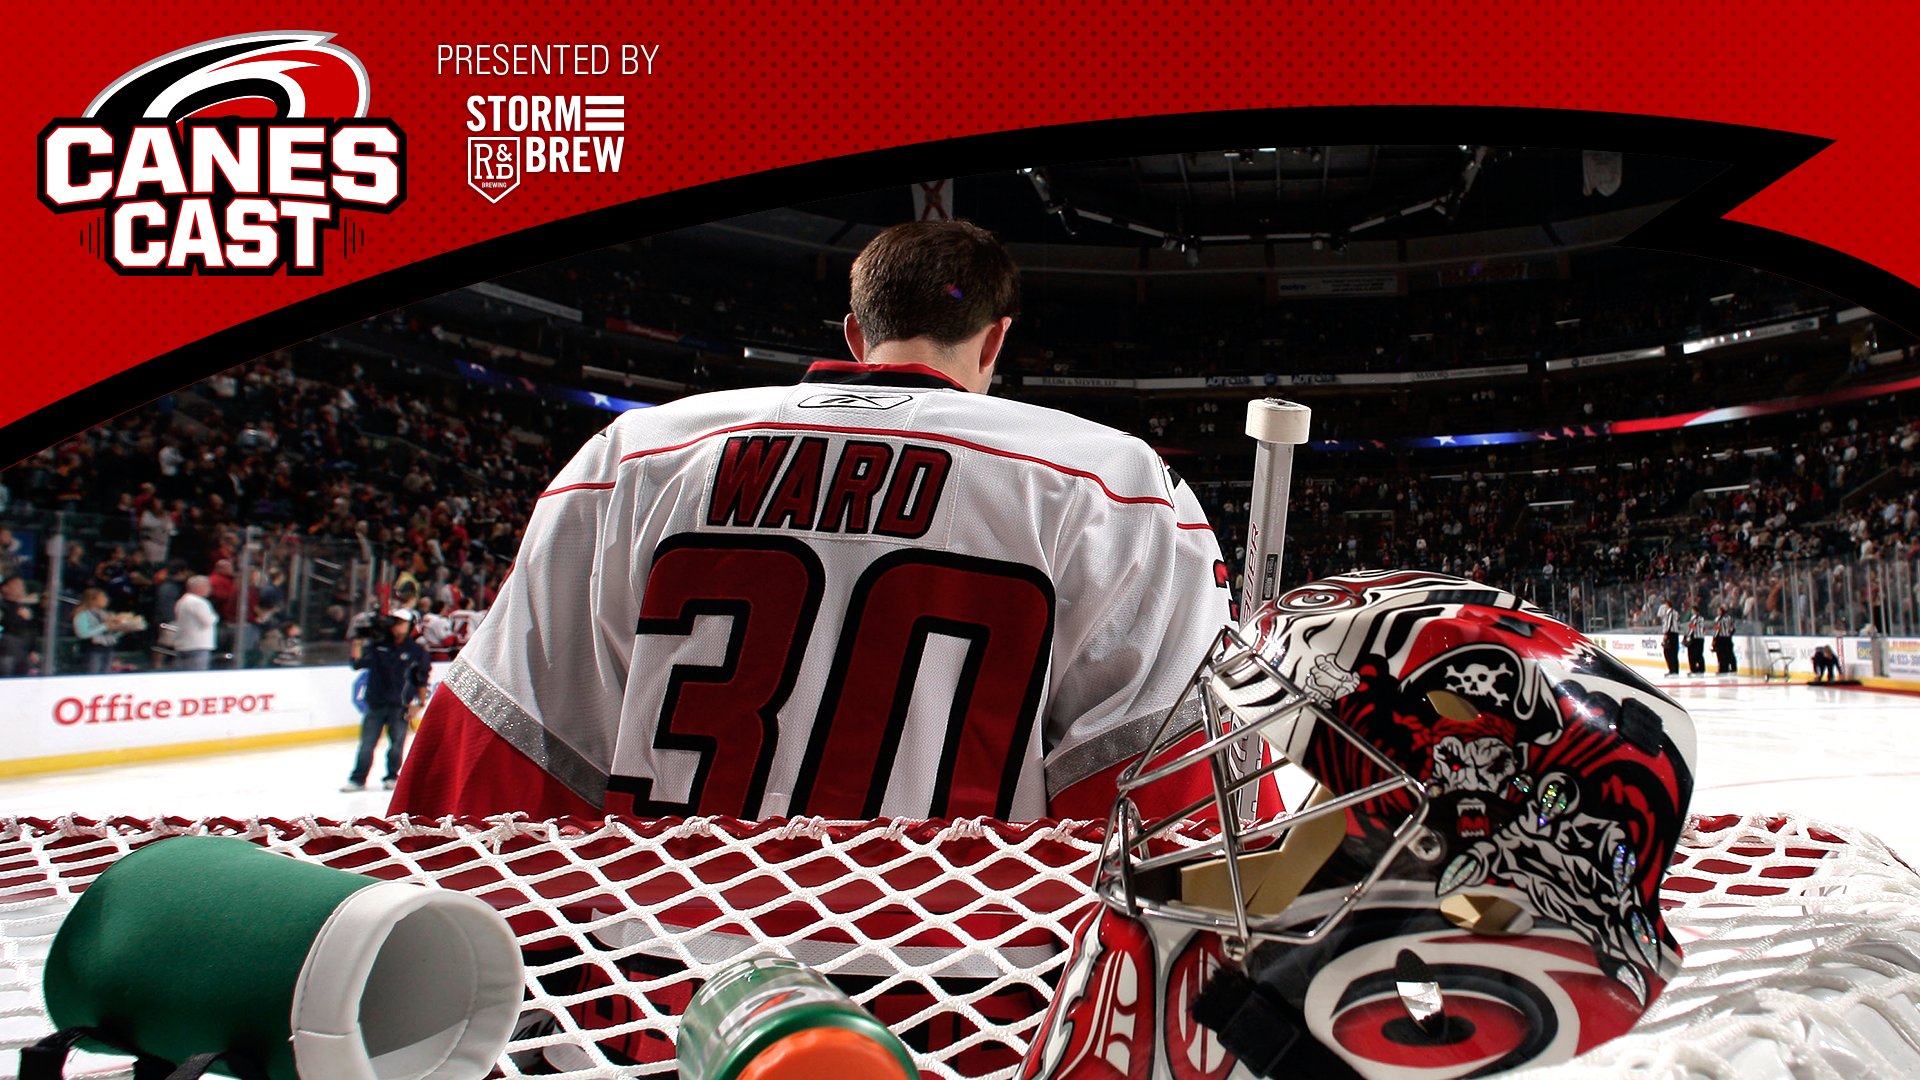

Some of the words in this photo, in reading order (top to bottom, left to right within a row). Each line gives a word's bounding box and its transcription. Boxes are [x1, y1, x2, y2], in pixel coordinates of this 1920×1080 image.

[708, 436, 953, 539] WARD
[53, 694, 171, 726] Office
[179, 694, 275, 718] DEPOT
[604, 531, 1056, 820] 30
